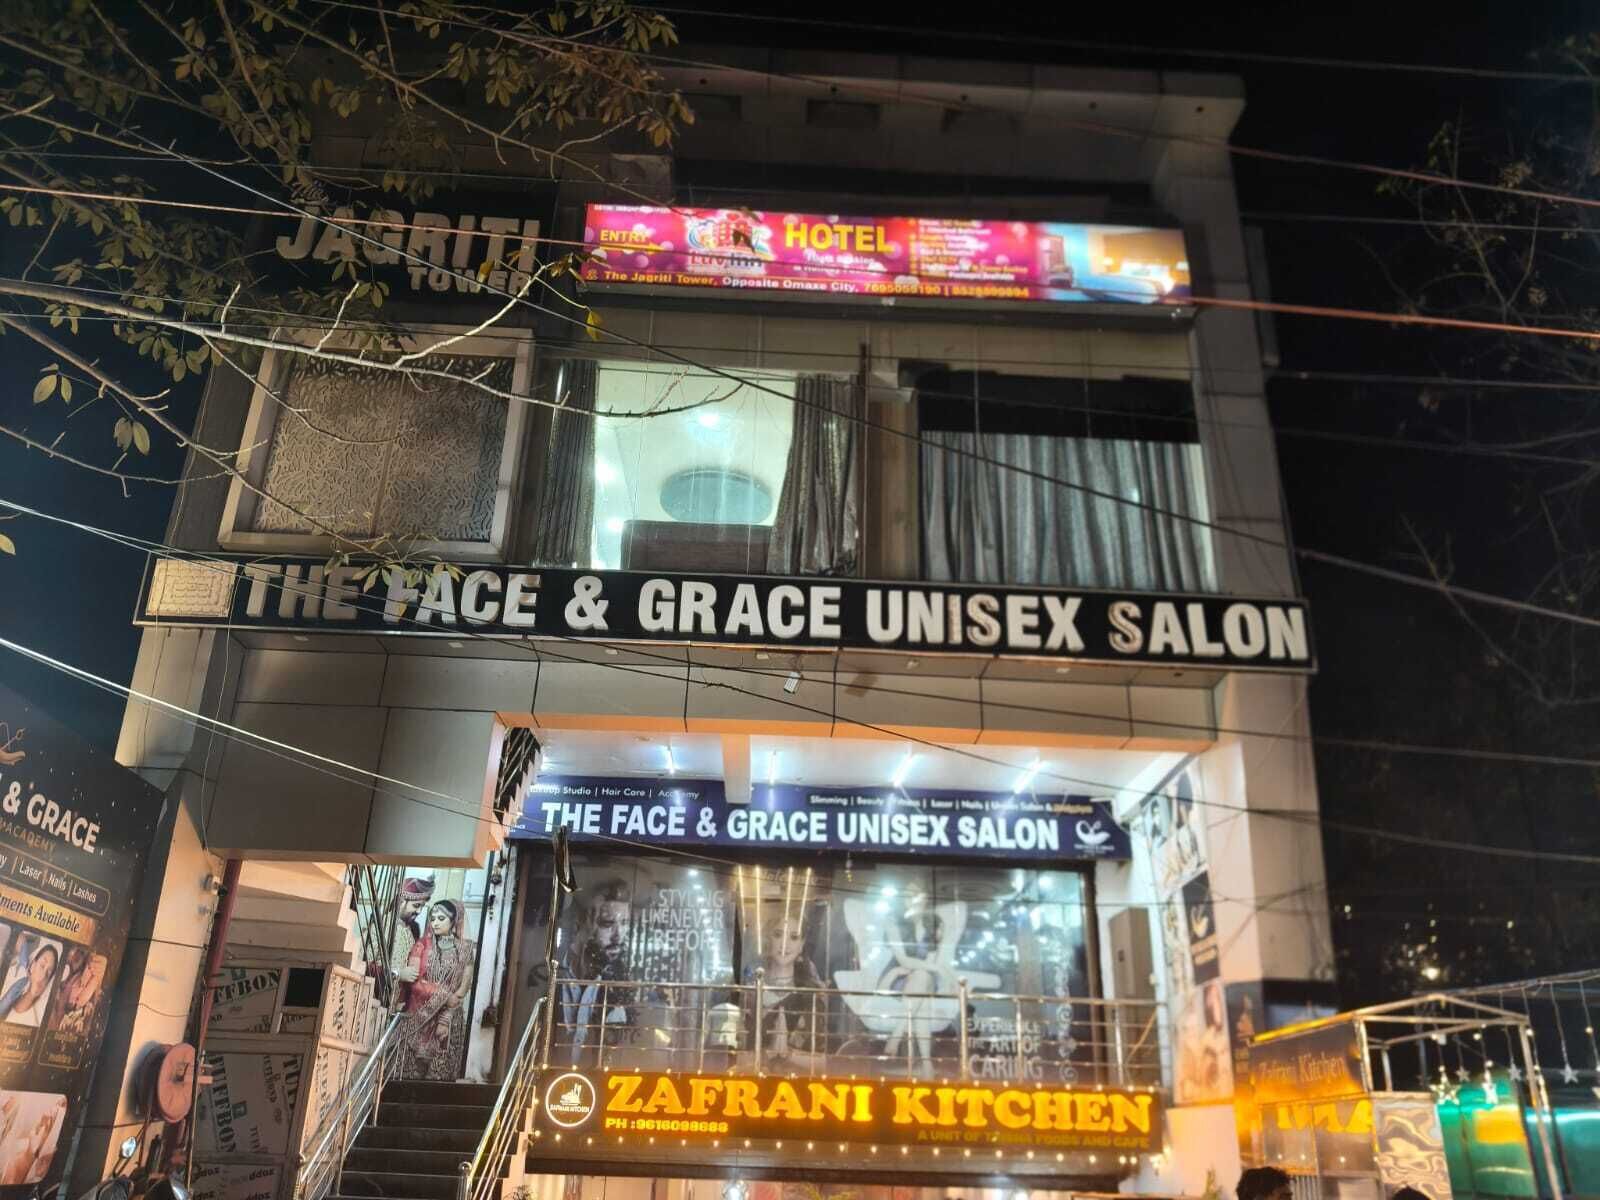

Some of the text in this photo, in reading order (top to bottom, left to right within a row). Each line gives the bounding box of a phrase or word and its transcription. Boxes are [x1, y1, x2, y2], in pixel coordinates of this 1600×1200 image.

[275, 205, 541, 272] JAGRITI
[600, 229, 649, 243] ENTRY
[784, 222, 894, 253] HOTEL
[408, 265, 533, 296] TOWER
[604, 270, 628, 281] The
[631, 271, 672, 284] Jagriti
[722, 276, 780, 289] Opposite
[783, 279, 827, 290] Omaxe
[242, 562, 1309, 660] THE FACE & GRACE UNISEX SALON
[563, 786, 591, 795] Studio
[602, 787, 620, 796] Hair
[623, 788, 645, 797] Care
[3, 781, 101, 854] & GRACE
[541, 802, 1059, 851] THE FACE & GRACE UNISEX SALON
[19, 858, 42, 881] Laser
[48, 872, 68, 891] Nails
[73, 882, 97, 904] Lashes
[0, 893, 80, 933] ments Available
[989, 1035, 1018, 1053] ART
[605, 1075, 1152, 1133] ZAFRANI KITCHEN
[605, 1118, 628, 1129] PH
